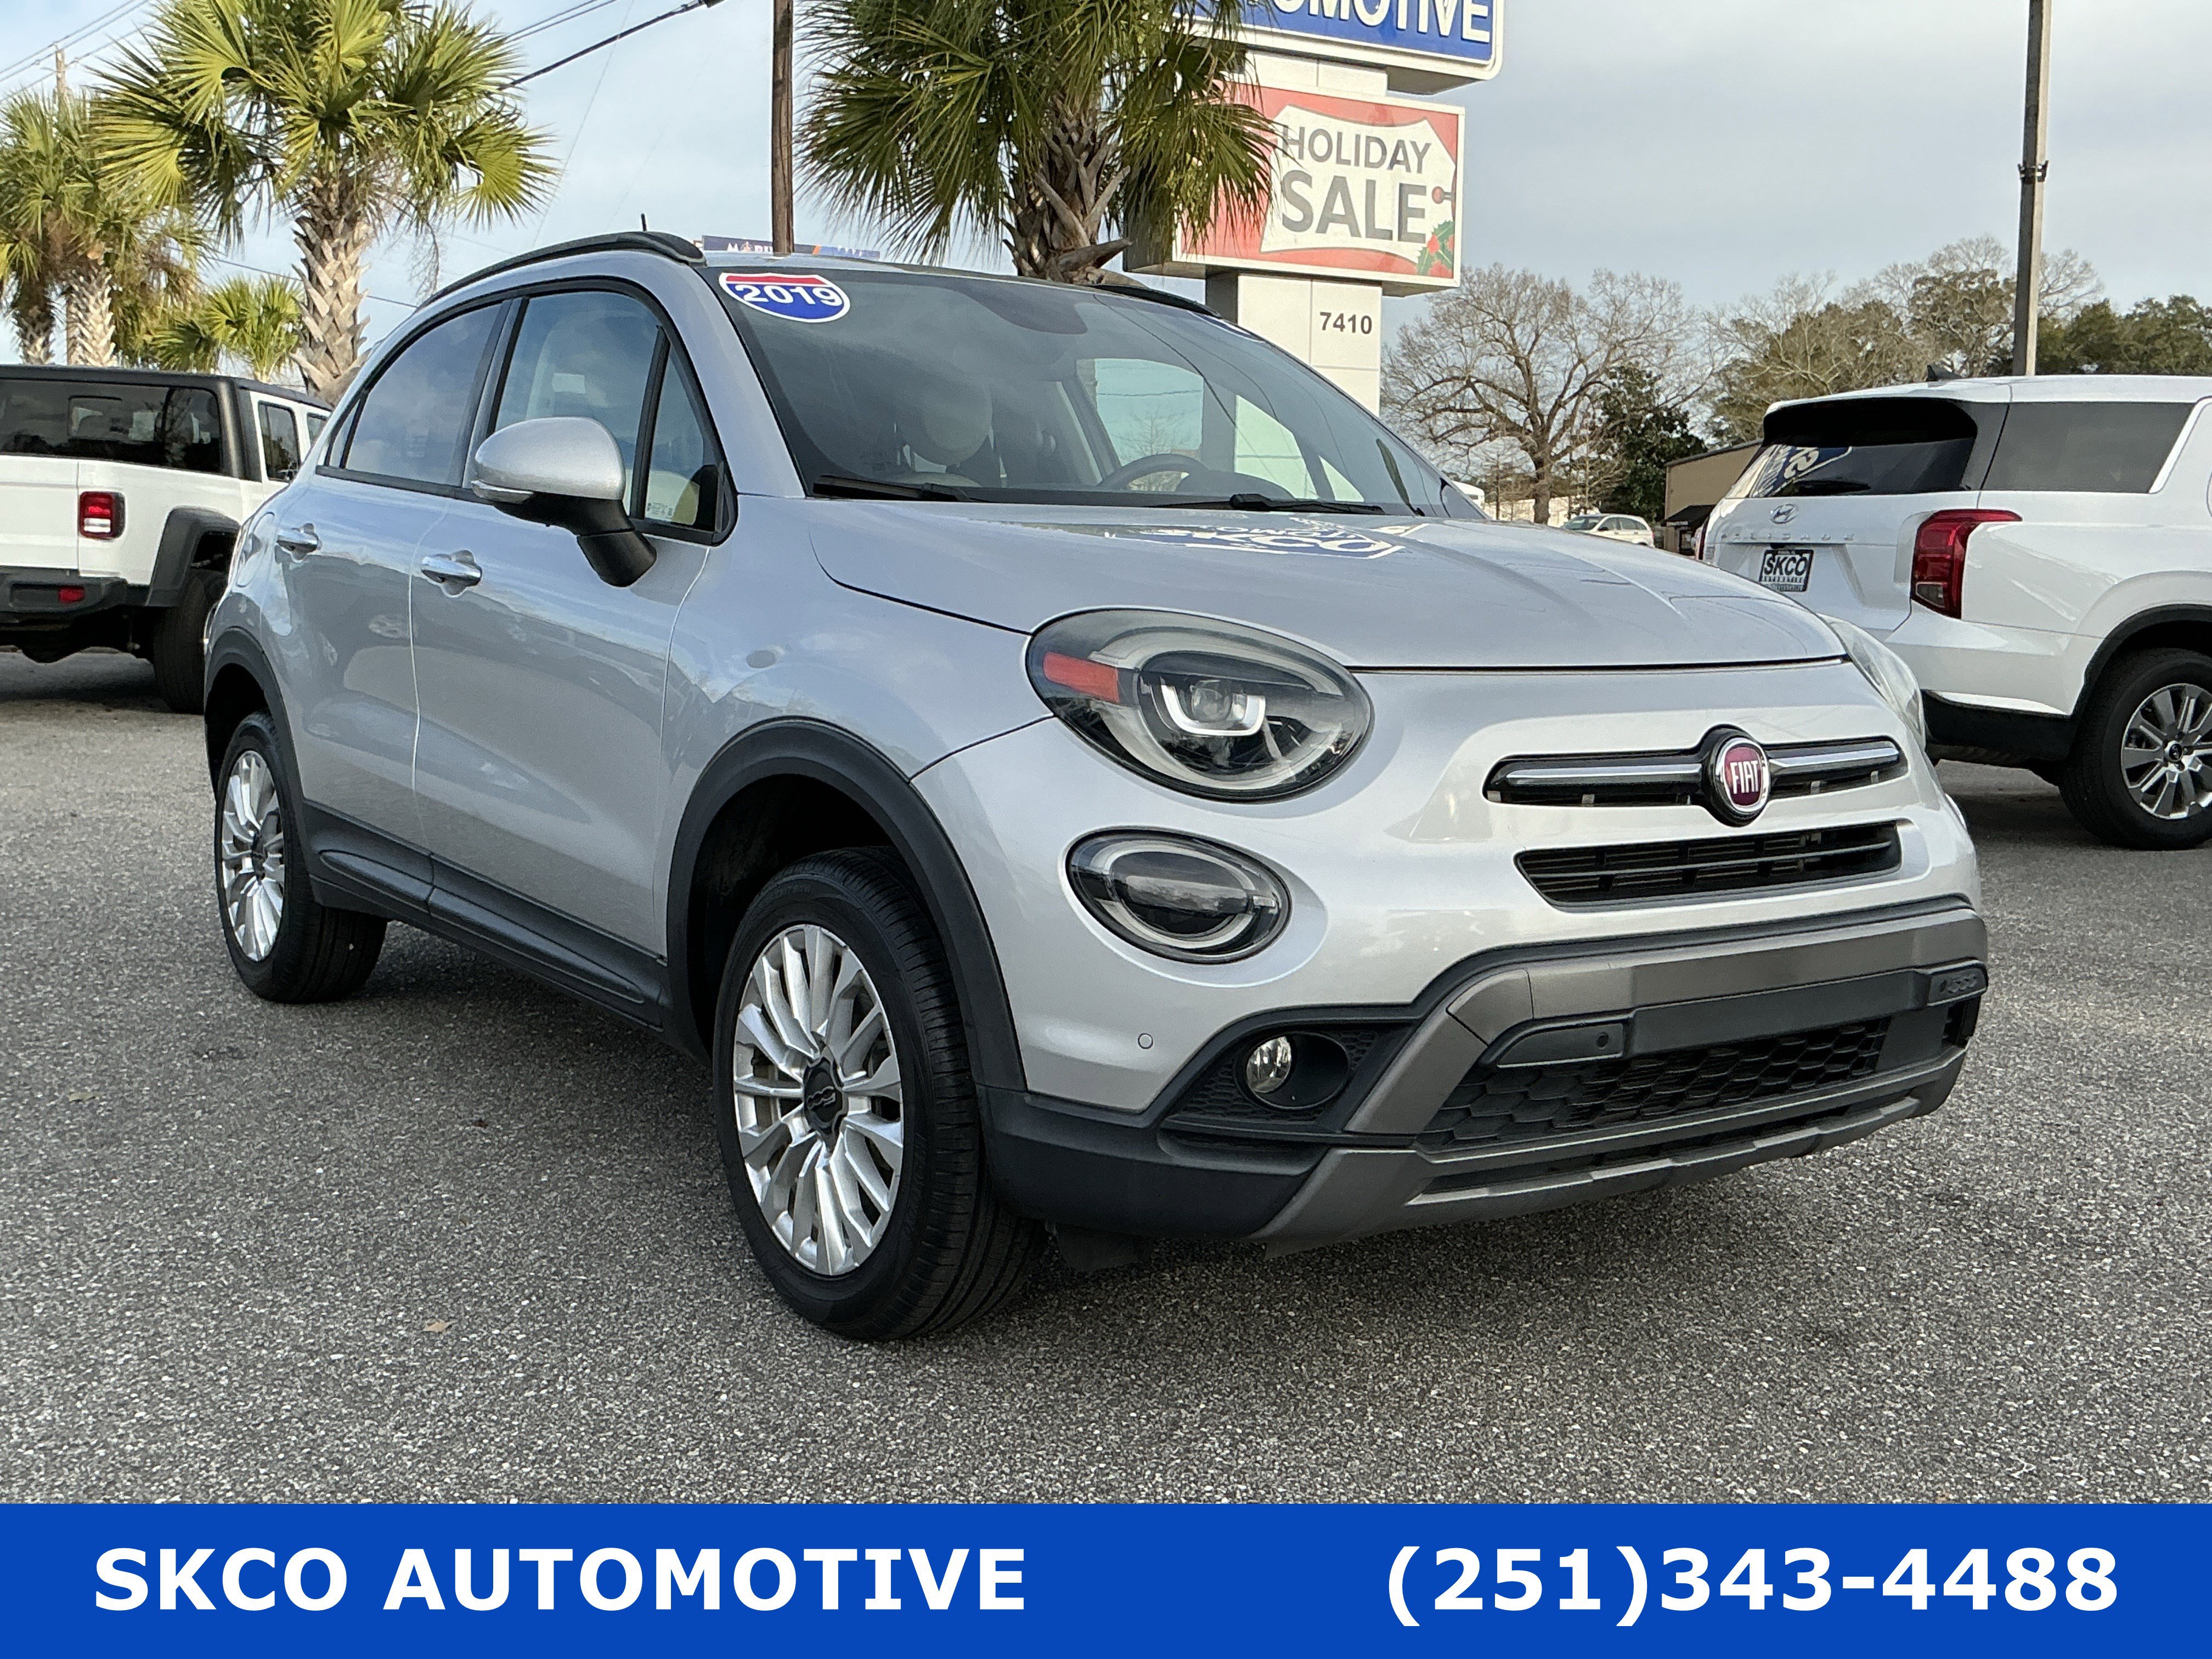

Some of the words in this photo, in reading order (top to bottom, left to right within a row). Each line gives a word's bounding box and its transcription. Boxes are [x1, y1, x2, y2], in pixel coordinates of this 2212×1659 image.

[1282, 126, 1432, 174] HOLIDAY
[1281, 170, 1427, 244] SALE
[735, 284, 843, 307] 2019
[1319, 312, 1373, 335] 7410
[1764, 556, 1808, 576] SKCO
[1729, 760, 1760, 794] FIAT
